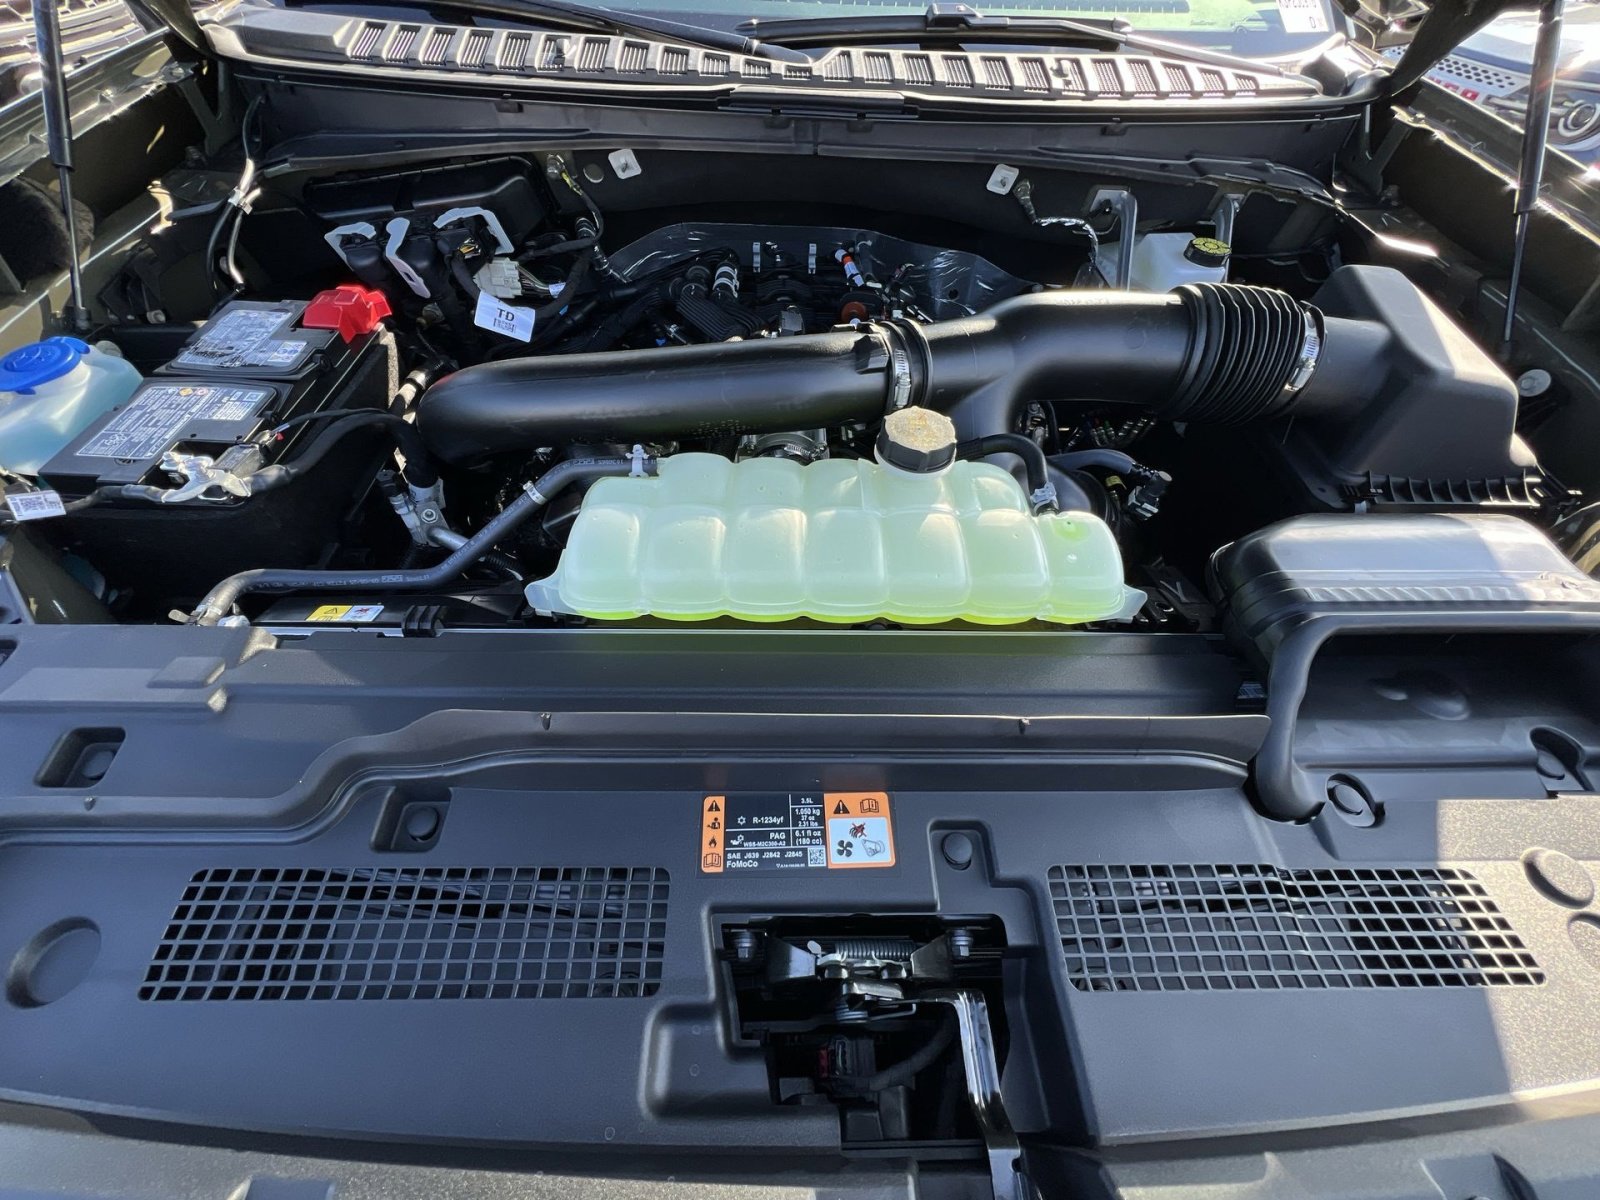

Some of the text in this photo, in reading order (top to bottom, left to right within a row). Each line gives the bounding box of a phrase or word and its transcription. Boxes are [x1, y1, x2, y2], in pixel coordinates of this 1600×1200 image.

[497, 307, 515, 322] TD
[812, 807, 820, 816] kg
[752, 816, 784, 824] R-1234yf
[769, 832, 786, 840] PAG
[795, 838, 823, 846] (180 cc)
[727, 852, 741, 860] SAE
[762, 851, 781, 859] J2842
[784, 850, 803, 858] J2845
[726, 860, 759, 868] FoMoCo
